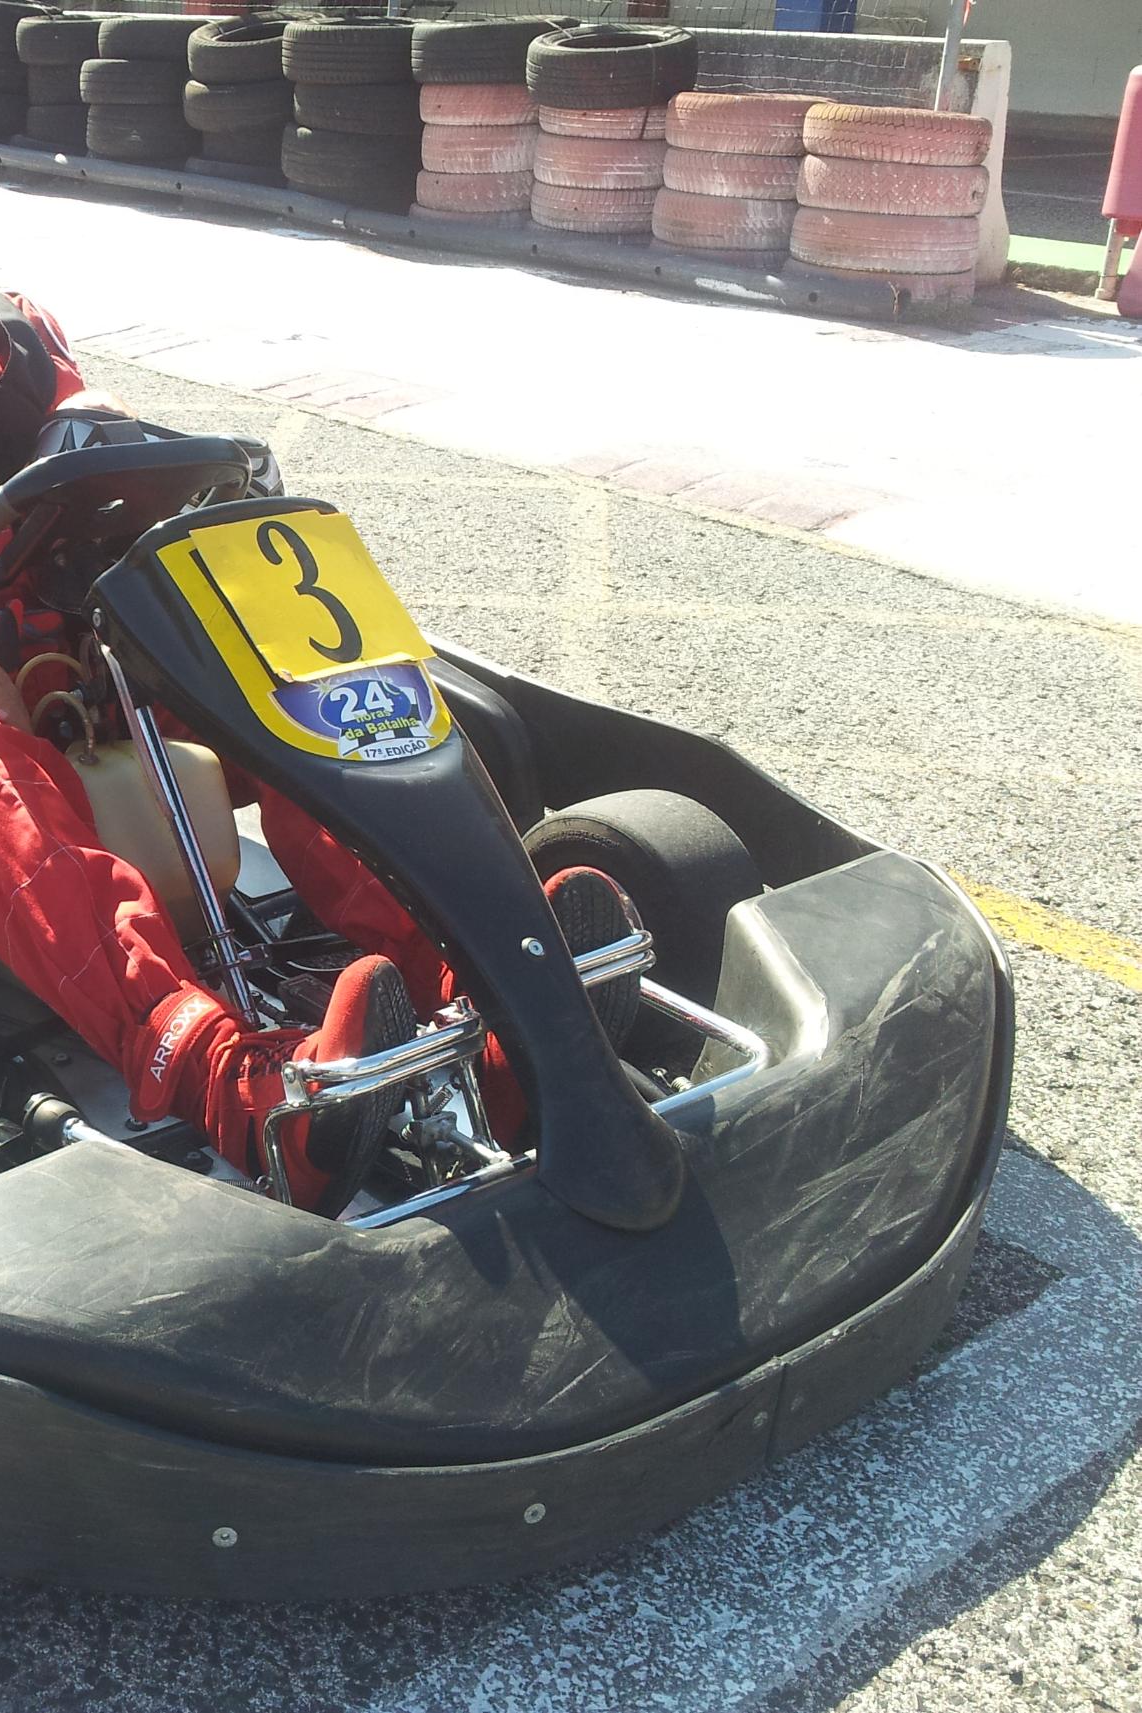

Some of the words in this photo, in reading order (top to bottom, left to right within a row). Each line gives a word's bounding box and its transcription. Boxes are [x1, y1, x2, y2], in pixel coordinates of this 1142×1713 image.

[256, 519, 363, 663] 3
[329, 681, 395, 723] 24
[345, 728, 365, 740] da
[365, 716, 419, 735] Batalha
[386, 739, 427, 757] EDIÇÃO
[149, 997, 207, 1083] ARROXX
